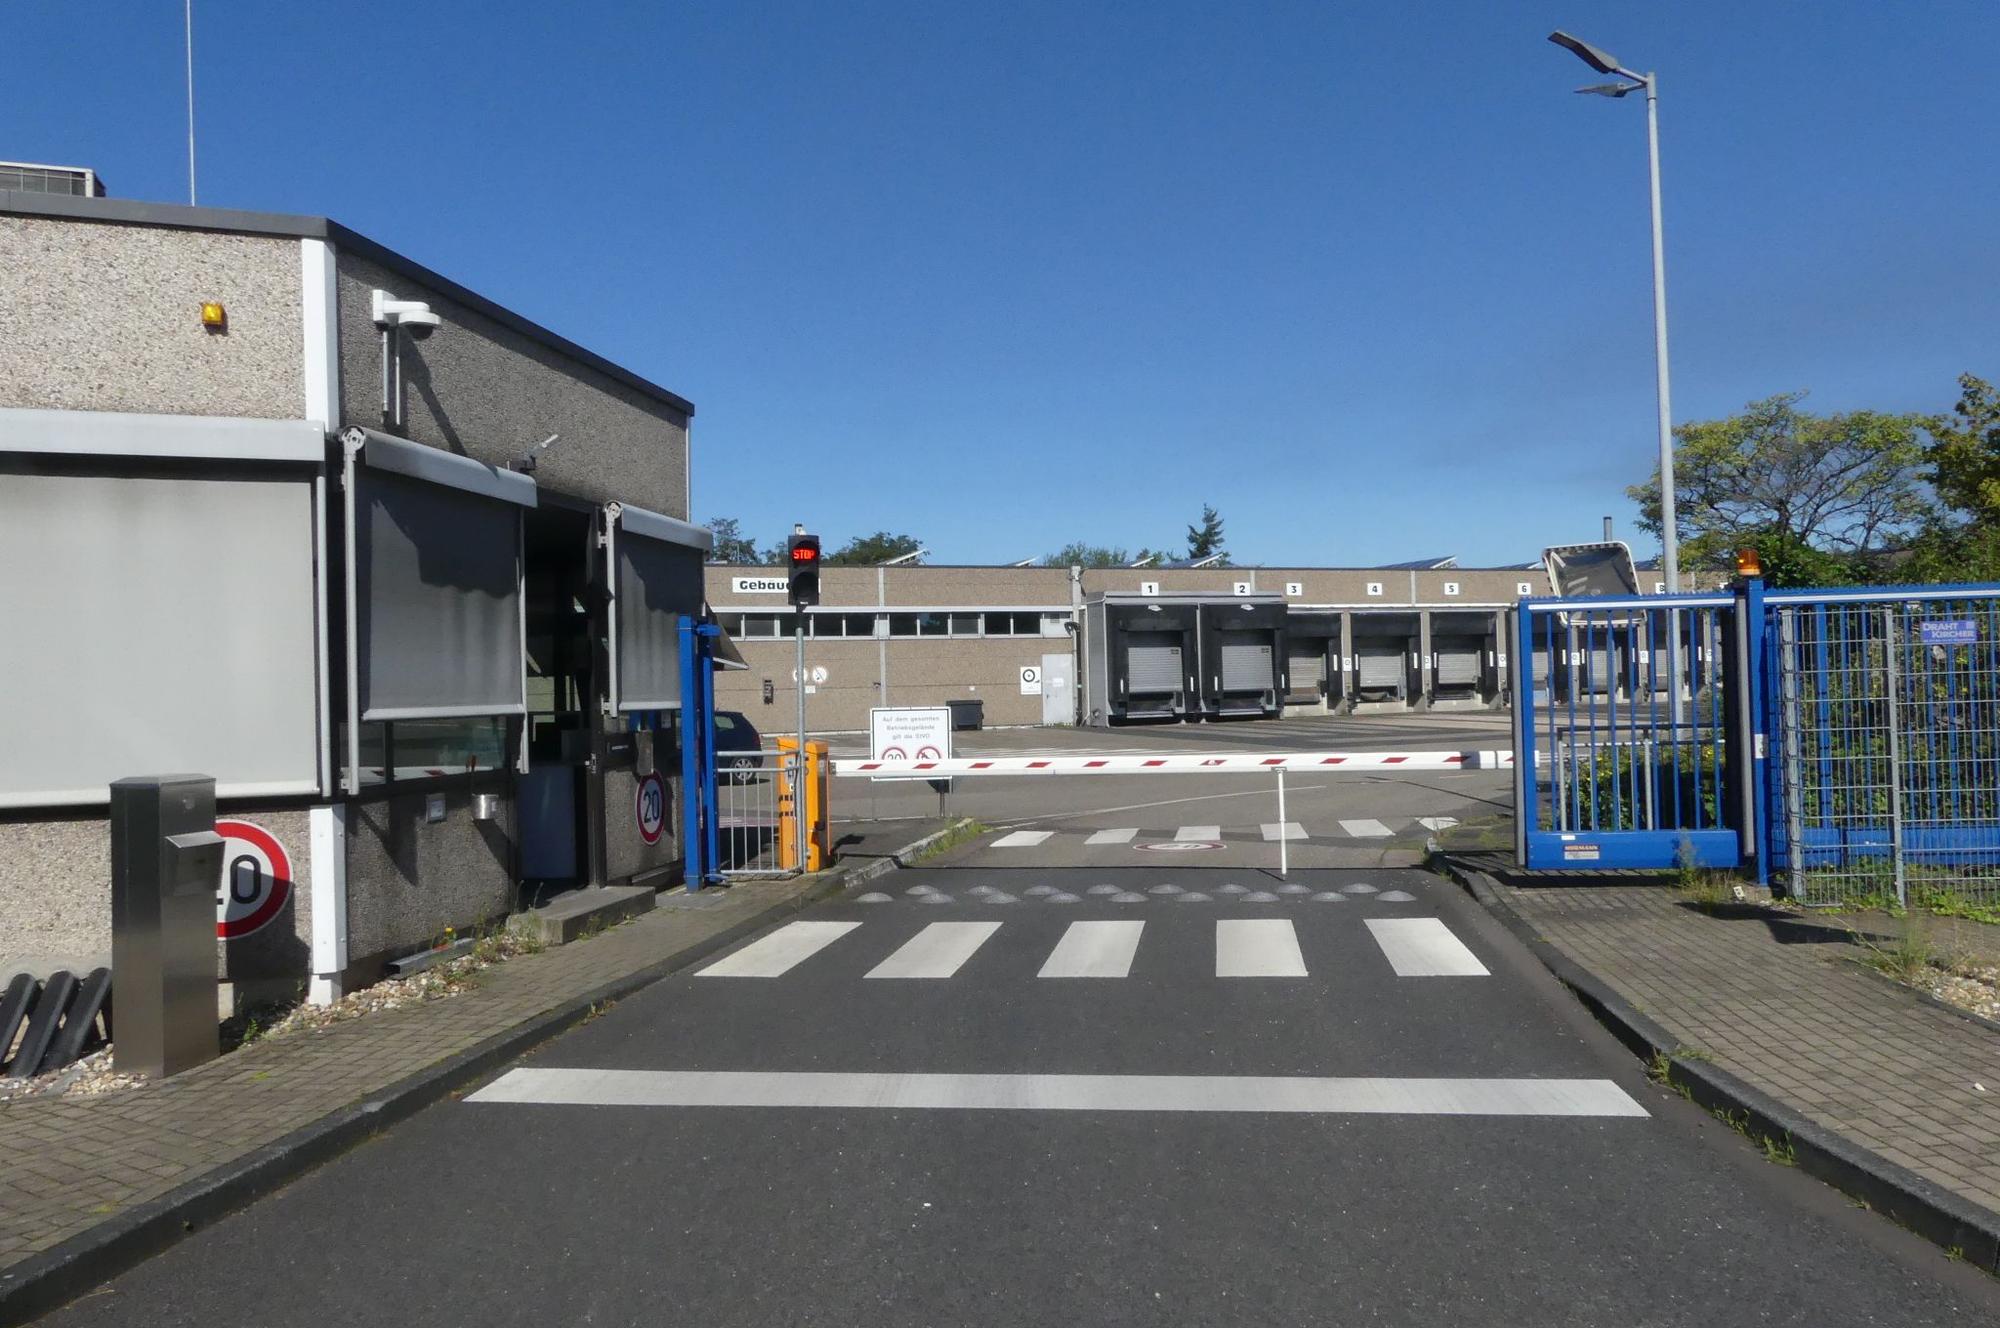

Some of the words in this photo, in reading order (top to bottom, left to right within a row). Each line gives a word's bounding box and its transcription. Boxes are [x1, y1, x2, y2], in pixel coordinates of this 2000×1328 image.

[793, 549, 815, 560] STOP
[740, 579, 789, 590] Gebäu
[1147, 585, 1153, 593] 1
[1239, 585, 1246, 593] 2
[1291, 585, 1297, 593] 3
[1371, 585, 1378, 593] 4
[1449, 585, 1454, 593] 5
[1522, 585, 1527, 593] 6
[1922, 622, 1957, 631] DRAHT
[644, 790, 661, 823] 20
[217, 854, 261, 904] 0
